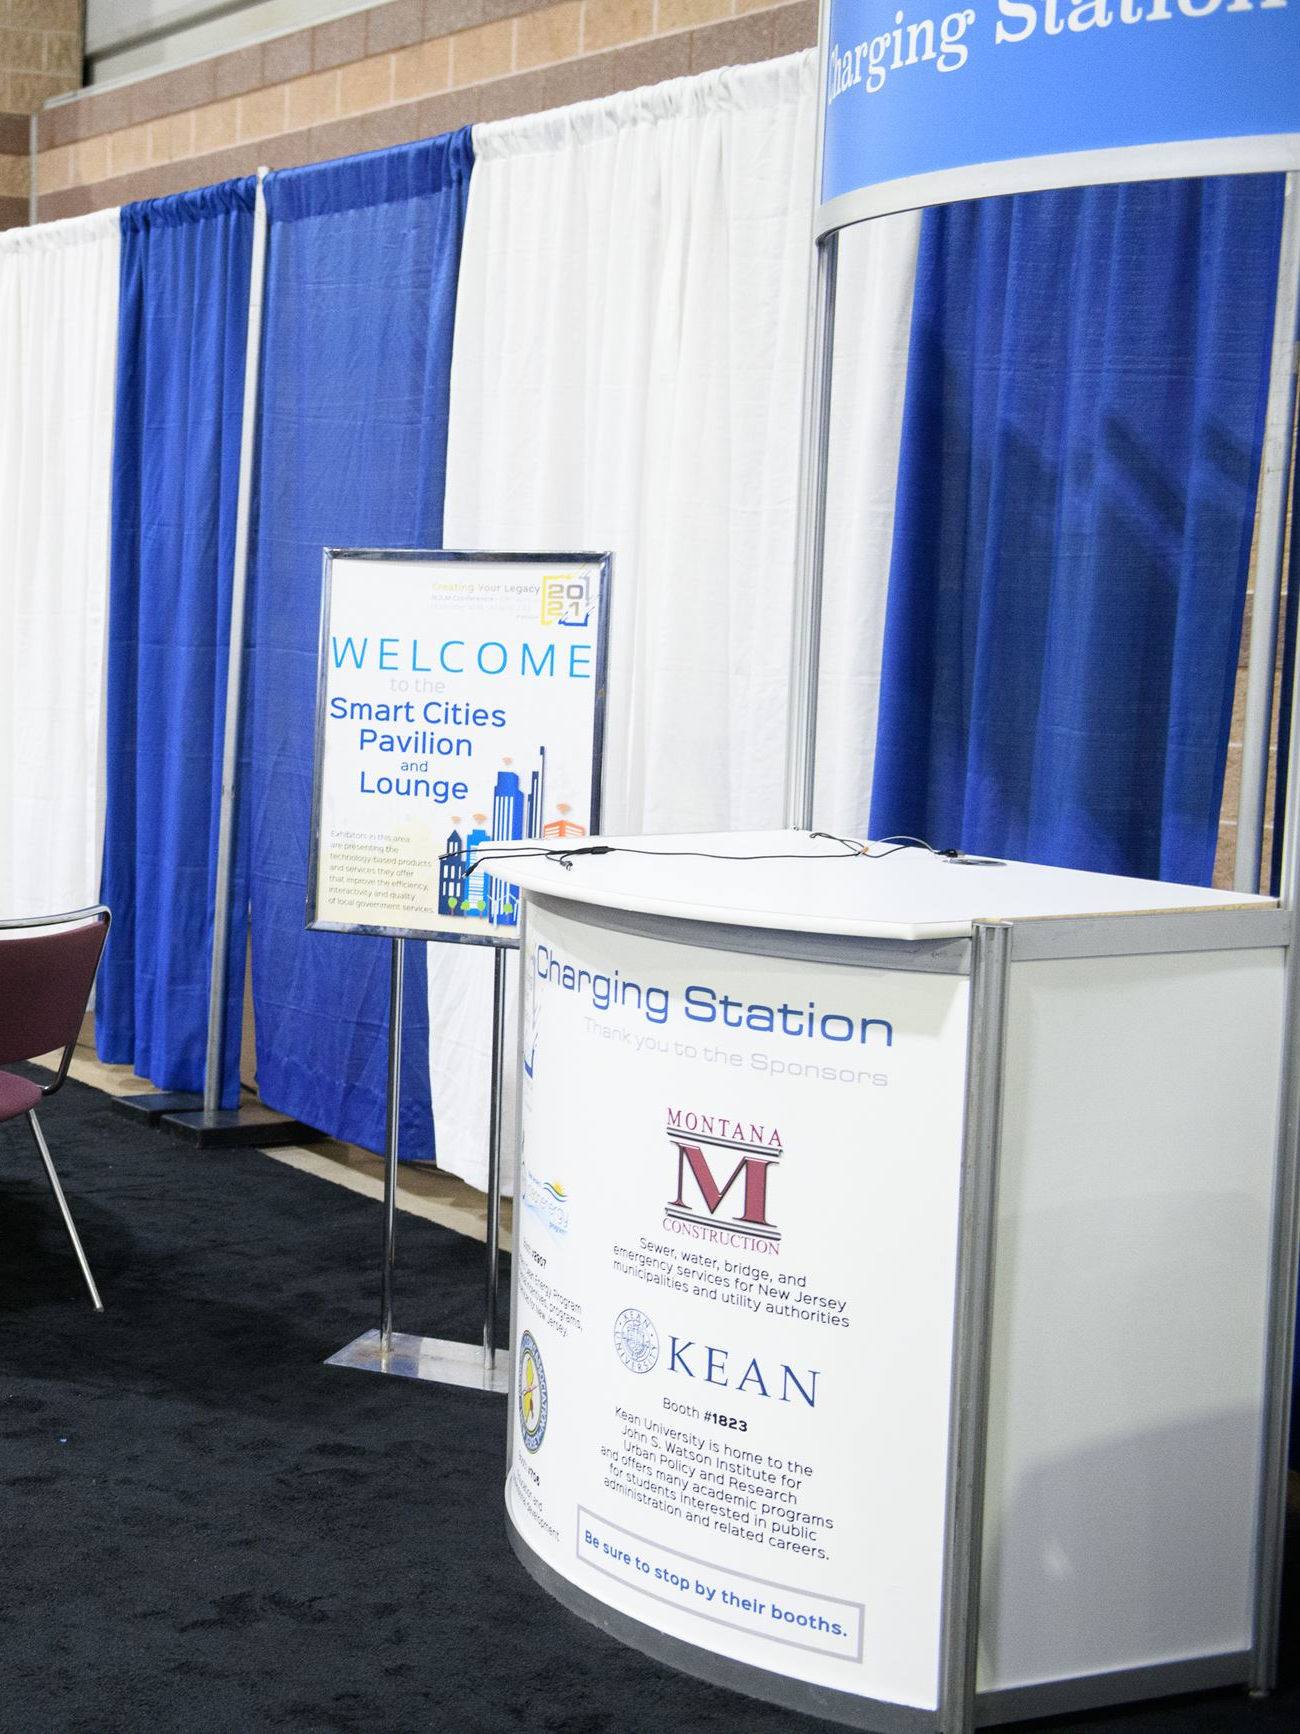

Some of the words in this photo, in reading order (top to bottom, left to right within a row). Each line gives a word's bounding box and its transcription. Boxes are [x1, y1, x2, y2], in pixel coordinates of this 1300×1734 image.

[478, 584, 500, 592] Your
[504, 584, 540, 595] Legacy
[332, 637, 592, 678] WELCOME
[391, 679, 408, 692] to
[414, 679, 445, 694] the
[330, 697, 414, 723] Smart
[424, 701, 506, 727] Cities
[360, 729, 472, 756] Pavilion
[400, 760, 428, 772] and
[360, 771, 468, 803] Lounge
[377, 868, 394, 877] they
[398, 857, 431, 868] products
[337, 898, 354, 906] local
[374, 889, 388, 897] and
[390, 891, 416, 901] quality
[536, 944, 669, 1024] Charging
[684, 986, 893, 1047] Station
[583, 1015, 631, 1042] Thank
[635, 1033, 670, 1053] you
[674, 1040, 697, 1059] to
[703, 1045, 743, 1067] the
[750, 1052, 889, 1088] Sponsors
[667, 1107, 782, 1147] MONTANA
[662, 1217, 780, 1255] CONSTRUCTION
[613, 1245, 673, 1275] emergency
[677, 1264, 730, 1289] services
[734, 1277, 754, 1293] for
[758, 1283, 790, 1301] New
[794, 1291, 847, 1314] Jersey
[639, 1237, 677, 1260] Sewer,
[681, 1250, 720, 1272] water,
[724, 1258, 773, 1283] bridge,
[778, 1272, 806, 1288] and
[613, 1259, 689, 1294] municipalities
[692, 1284, 717, 1301] and
[722, 1291, 761, 1312] utility
[765, 1301, 850, 1328] authorities
[623, 1310, 651, 1328] KEAN
[615, 1331, 657, 1371] UNIVERSITY
[667, 1335, 822, 1408] KEAN
[663, 1397, 700, 1420] Booth
[703, 1410, 748, 1432] #1823
[615, 1405, 641, 1426] Kean
[644, 1416, 705, 1451] University
[709, 1439, 720, 1453] is
[724, 1442, 763, 1465] home
[767, 1455, 783, 1470] to
[787, 1457, 813, 1477] the
[621, 1424, 648, 1444] John
[651, 1435, 662, 1450] S.
[665, 1440, 712, 1467] Watson
[716, 1457, 777, 1484] Institute
[781, 1472, 803, 1491] for
[600, 1445, 619, 1462] and
[622, 1455, 653, 1477] offers
[656, 1469, 689, 1491] many
[692, 1481, 757, 1511] academic
[761, 1502, 834, 1530] programs
[623, 1439, 657, 1463] Urban
[660, 1453, 696, 1478] Policy
[699, 1469, 725, 1486] and
[729, 1476, 798, 1505] Research
[603, 1475, 682, 1518] administration
[686, 1510, 710, 1528] and
[714, 1519, 764, 1544] related
[768, 1536, 831, 1561] careers.
[609, 1462, 624, 1478] for
[626, 1471, 677, 1501] students
[680, 1491, 750, 1524] interested
[754, 1513, 767, 1529] in
[772, 1519, 817, 1542] public
[584, 1529, 600, 1549] Be
[603, 1541, 632, 1565] sure
[635, 1556, 651, 1574] to
[654, 1566, 691, 1591] stop
[695, 1579, 717, 1601] by
[721, 1589, 766, 1616] their
[771, 1603, 848, 1638] booths.
